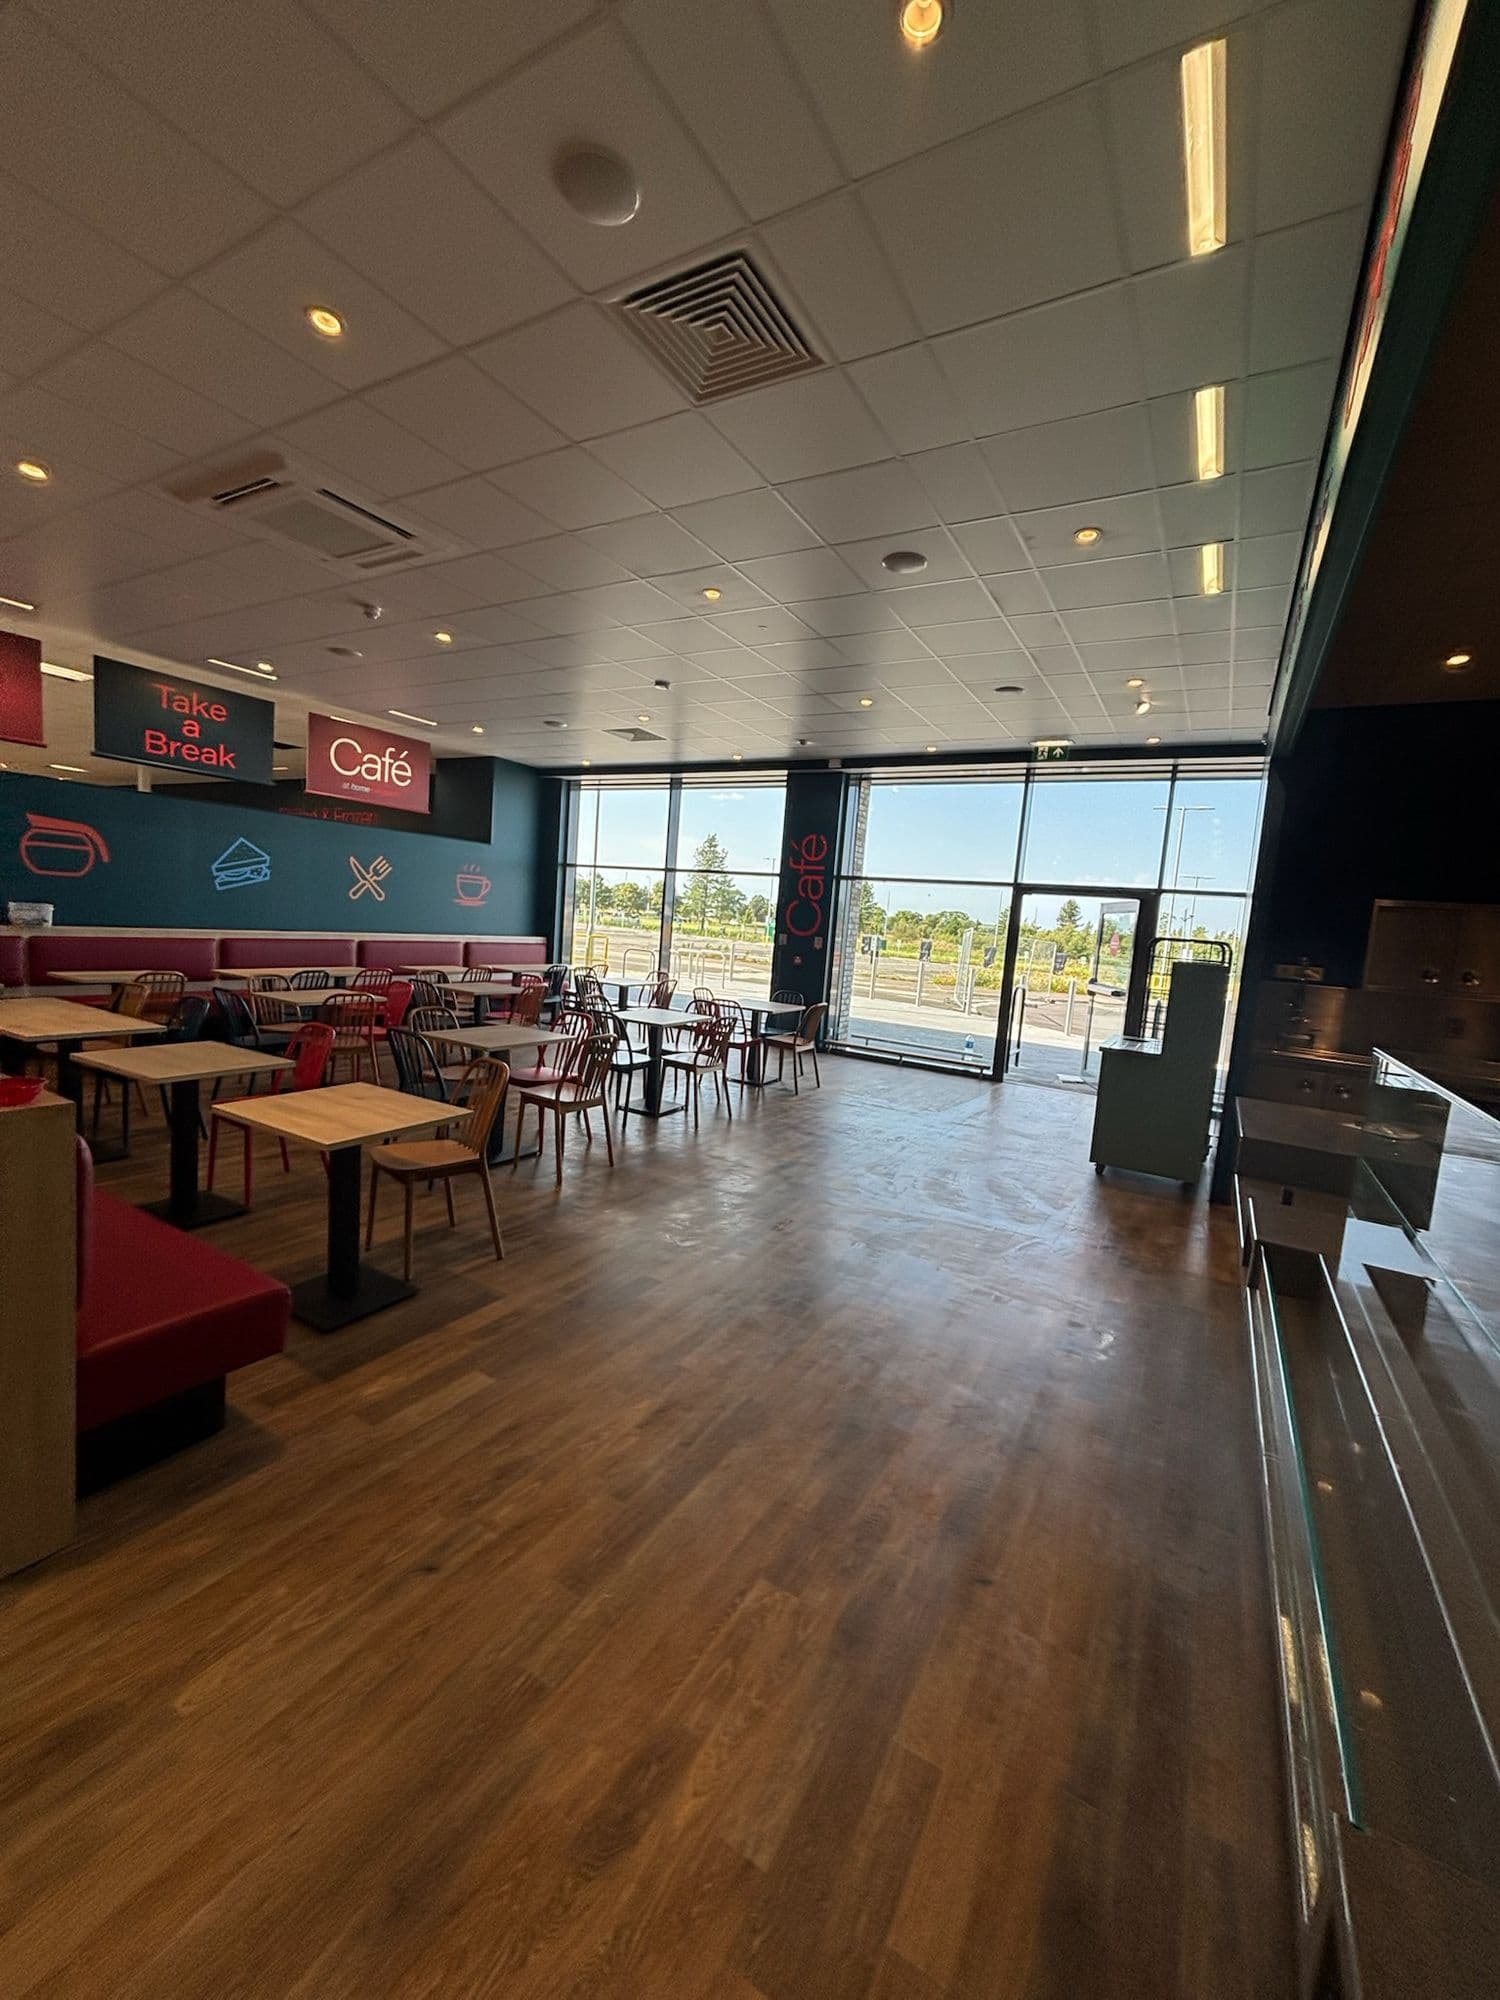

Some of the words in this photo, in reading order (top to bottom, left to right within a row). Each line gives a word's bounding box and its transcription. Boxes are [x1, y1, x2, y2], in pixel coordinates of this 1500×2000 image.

[151, 683, 228, 721] Take
[181, 719, 200, 738] a
[144, 729, 236, 769] Break
[330, 738, 412, 786] Café
[785, 833, 830, 937] Café
